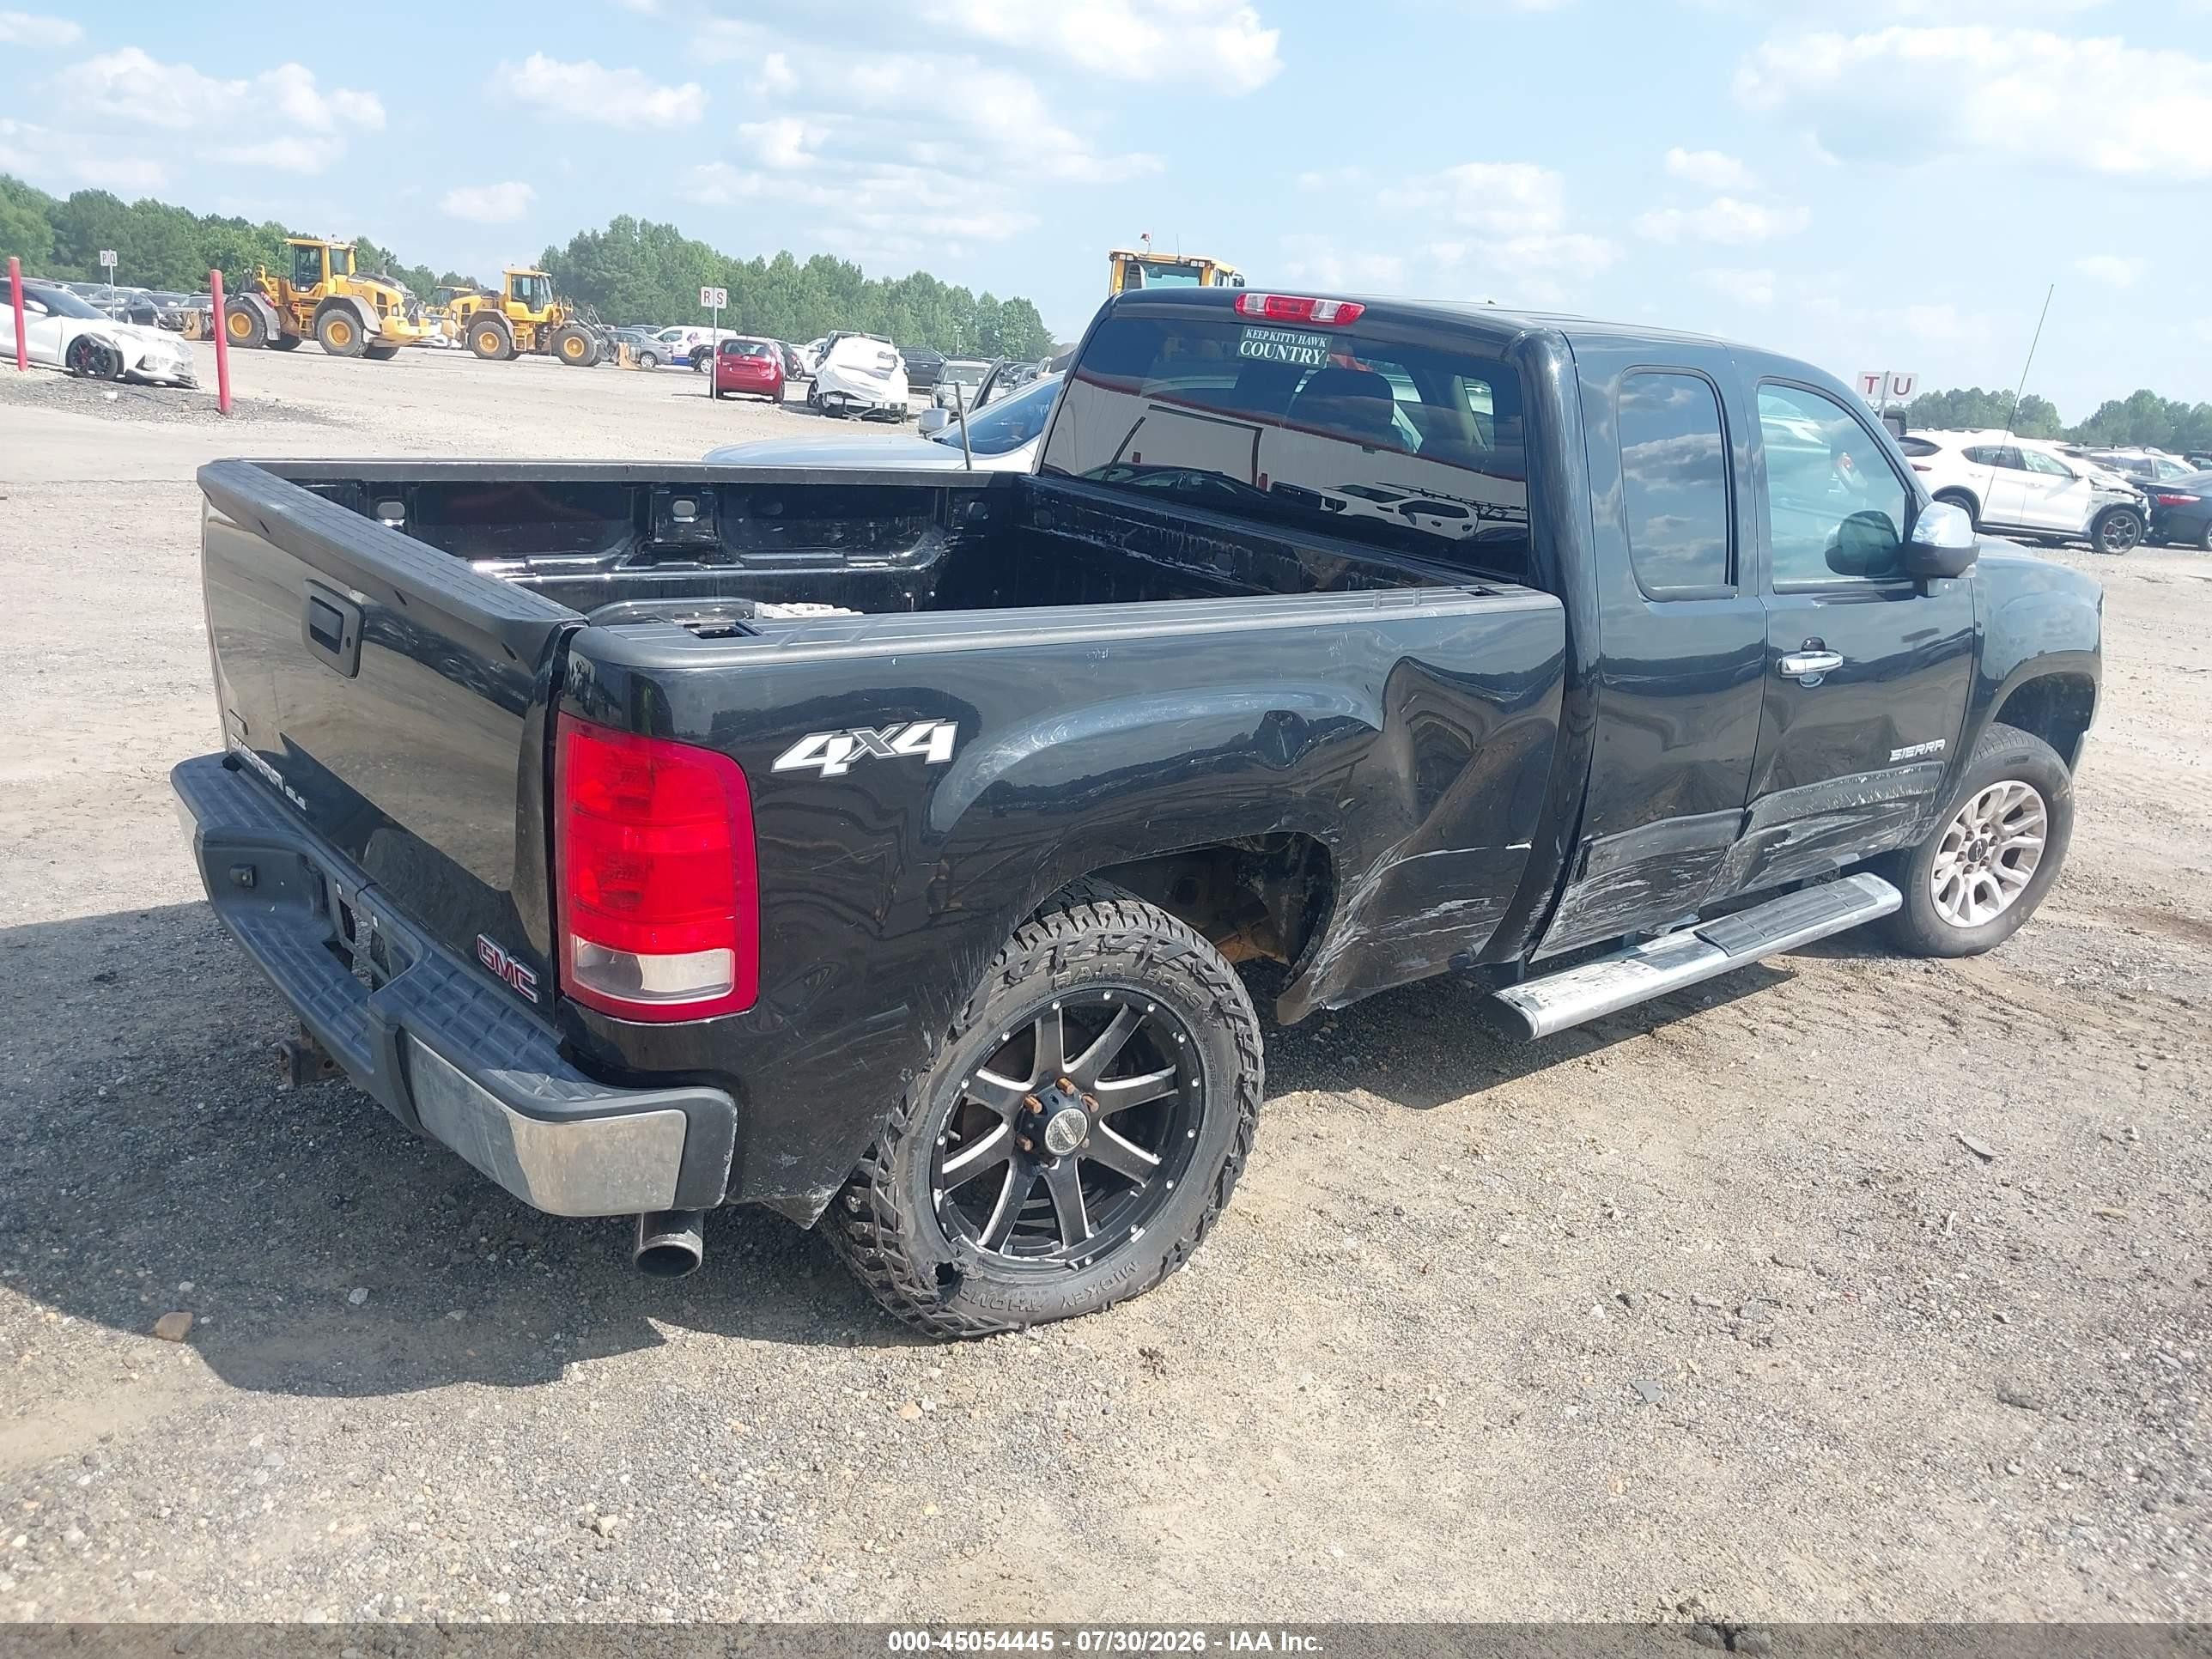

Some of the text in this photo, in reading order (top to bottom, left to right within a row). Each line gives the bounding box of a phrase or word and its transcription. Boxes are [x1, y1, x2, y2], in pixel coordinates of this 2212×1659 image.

[110, 253, 116, 264] Q
[703, 290, 724, 305] R S
[1246, 329, 1328, 348] KEEP KITTY HAWK
[1240, 340, 1326, 365] COUNTRY
[1864, 376, 1912, 396] T U
[1889, 738, 1946, 763] SIERRA
[477, 934, 539, 1004] GMC
[1143, 968, 1204, 1011] BOSS
[1060, 1260, 1141, 1310] MICKEY
